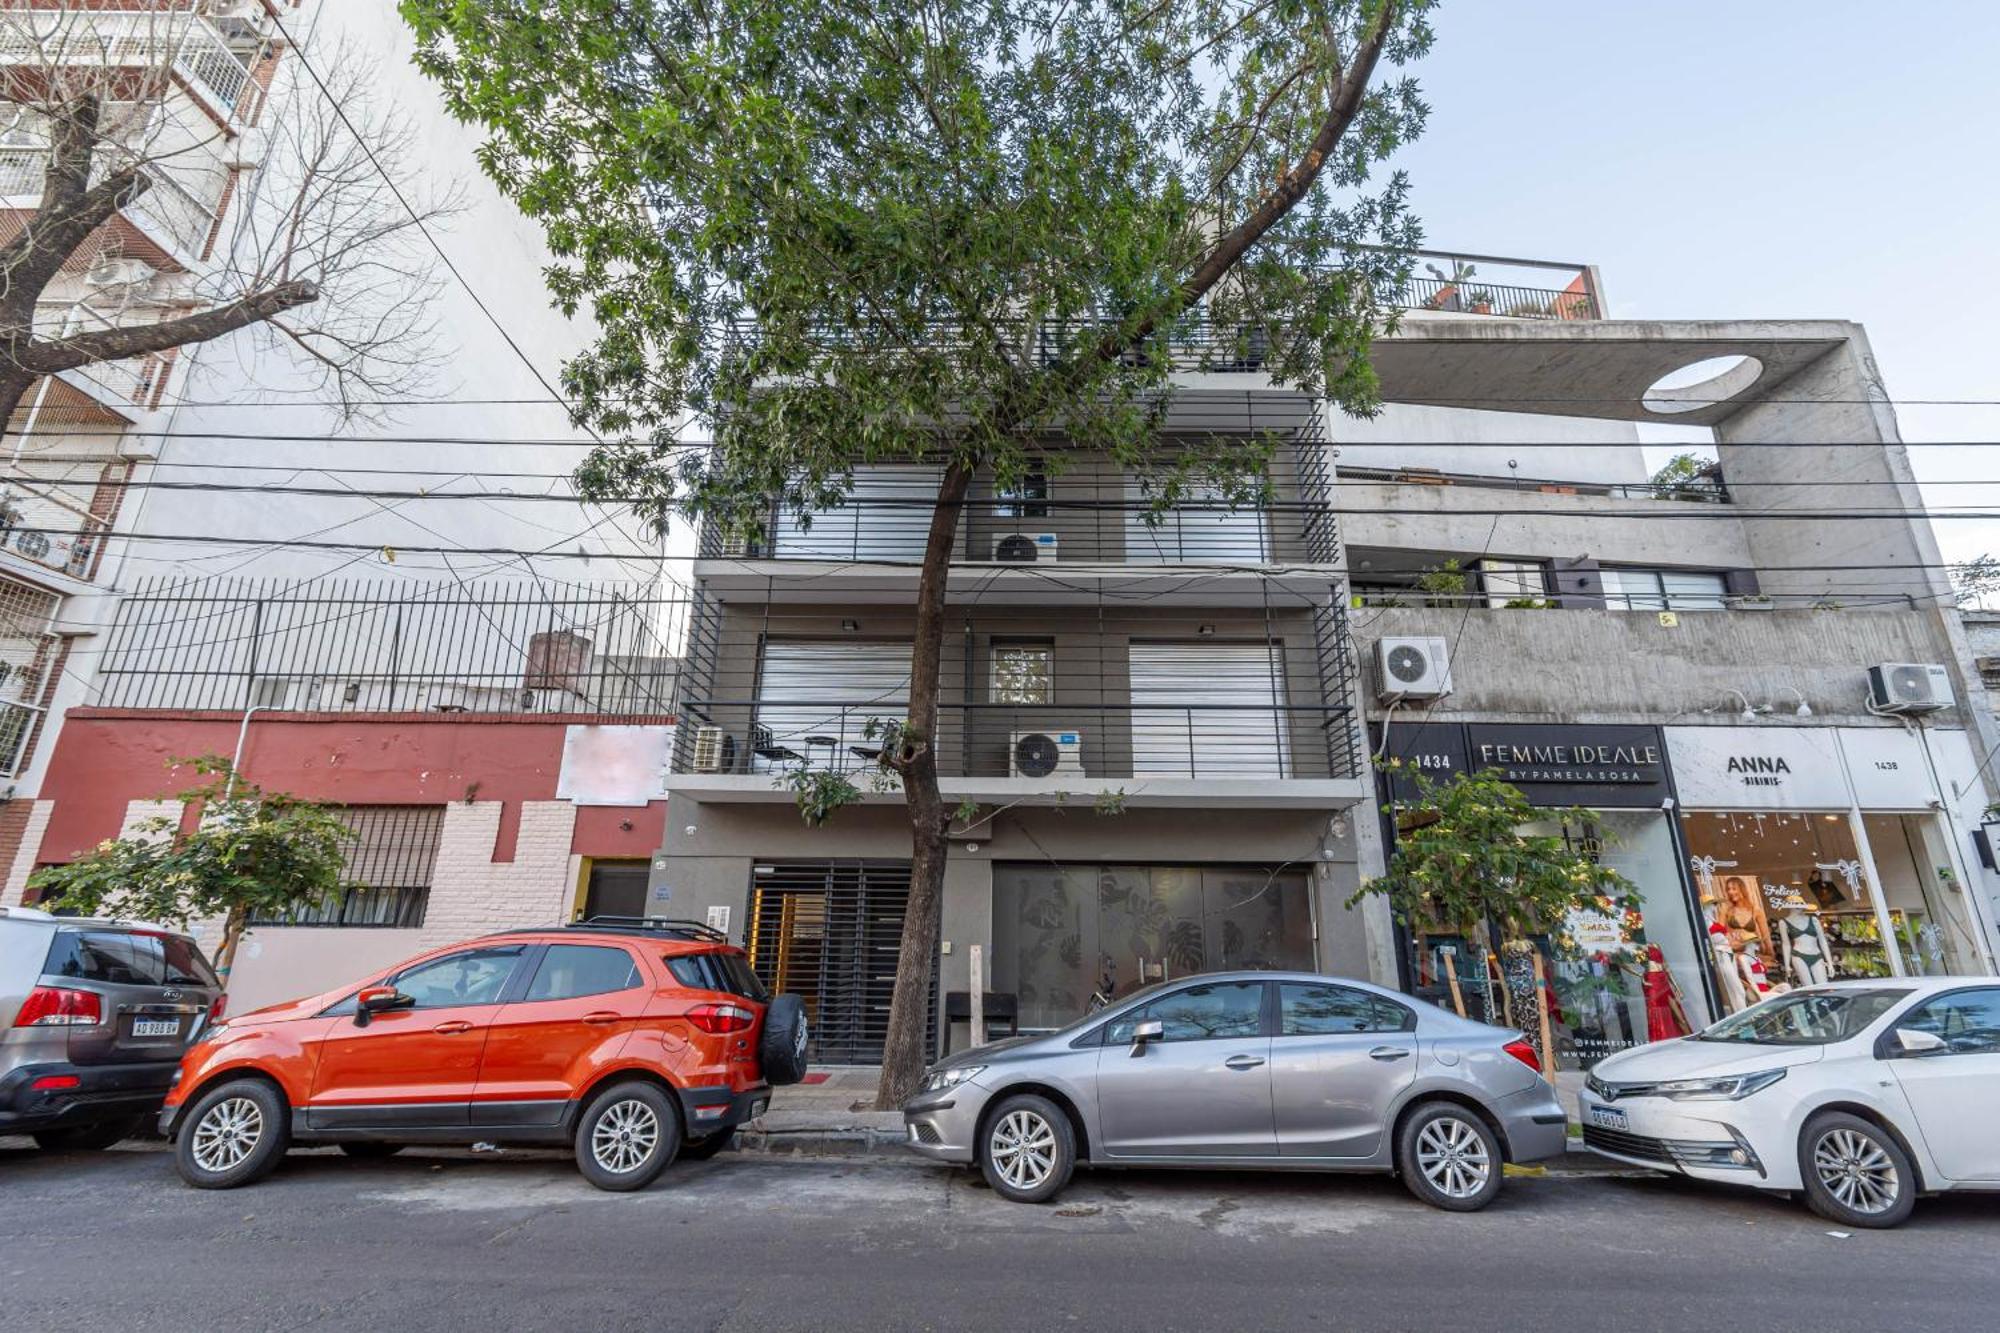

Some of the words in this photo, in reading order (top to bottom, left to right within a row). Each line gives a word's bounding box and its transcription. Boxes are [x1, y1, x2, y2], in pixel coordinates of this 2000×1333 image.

[1415, 754, 1451, 769] 1434
[1481, 744, 1568, 763] FEMME
[1574, 746, 1660, 764] IDEALE
[1727, 756, 1792, 774] ANNA
[1509, 771, 1526, 779] BY
[1533, 771, 1593, 780] PAMELA
[1600, 772, 1641, 780] SOSA
